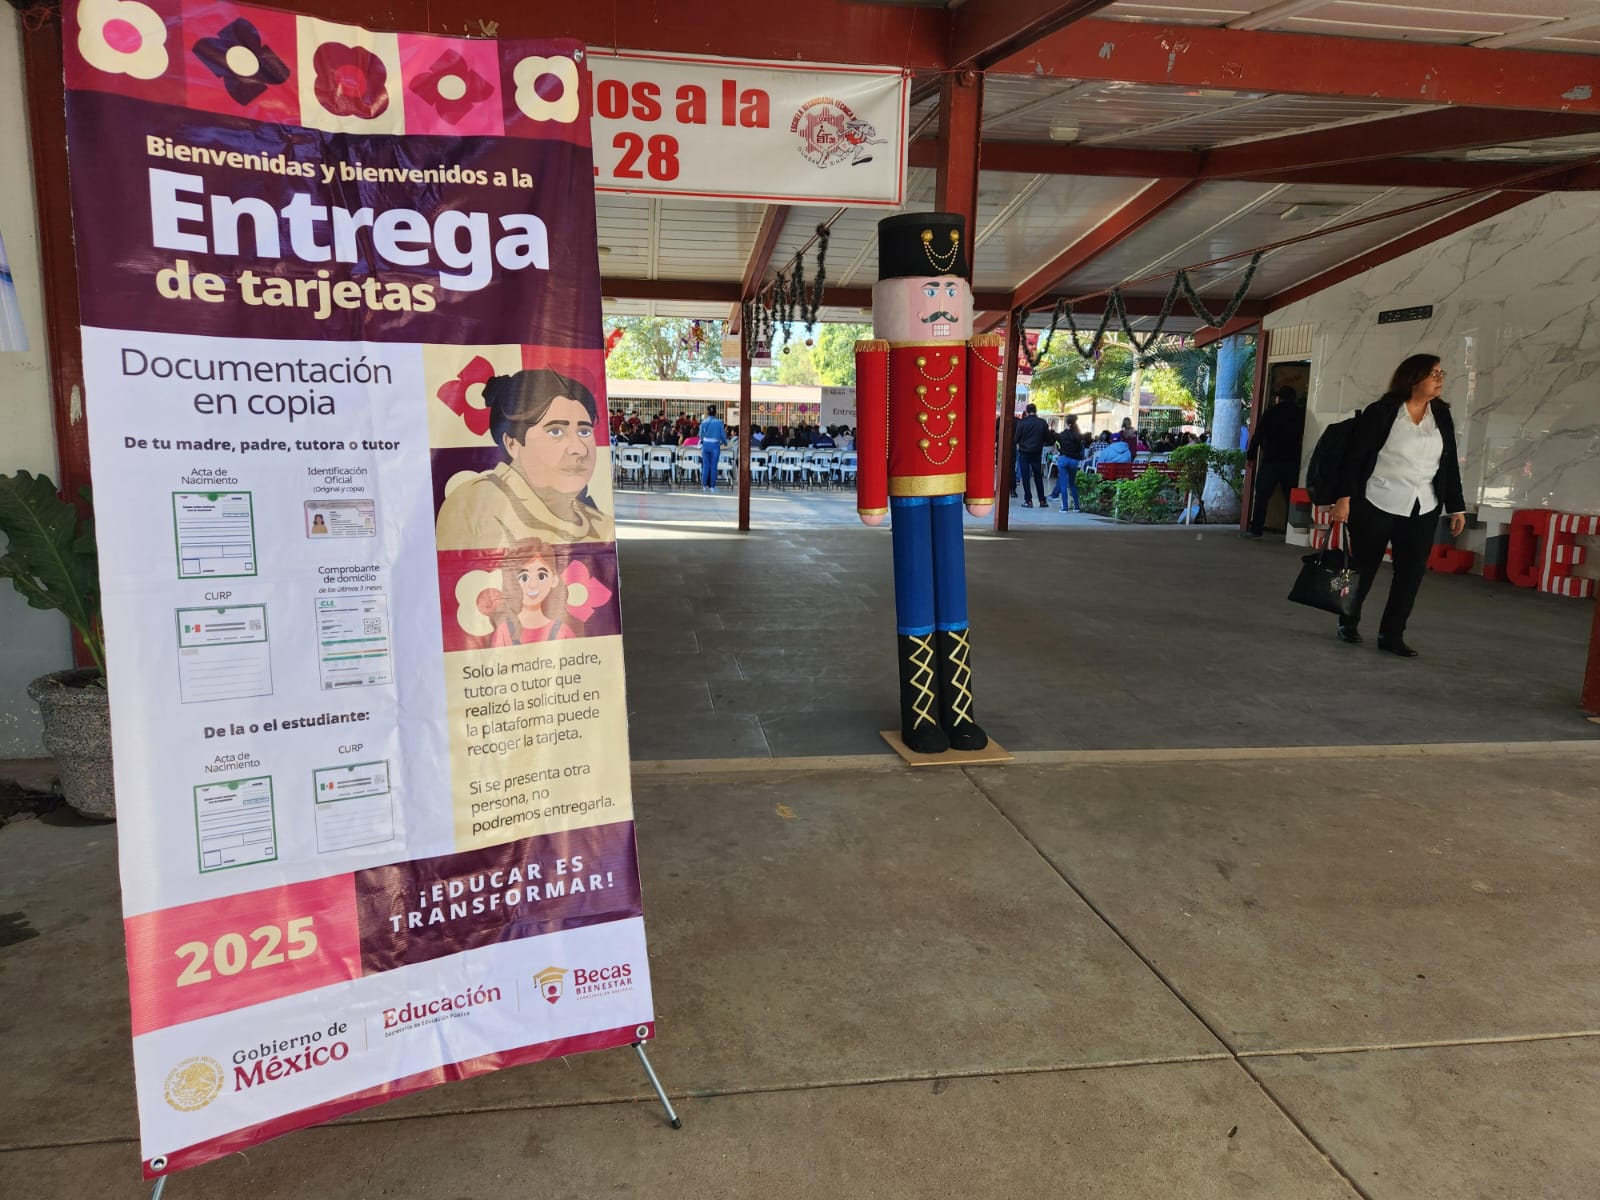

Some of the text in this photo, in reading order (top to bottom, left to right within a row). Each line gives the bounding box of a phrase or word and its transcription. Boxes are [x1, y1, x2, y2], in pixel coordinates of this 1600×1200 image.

[675, 84, 707, 125] a
[722, 79, 770, 129] la
[146, 134, 533, 188] Bienvenidas y bienvenidos a la
[612, 131, 680, 182] 28
[148, 167, 550, 291] Entrega
[155, 259, 437, 320] de tarjetas
[120, 347, 393, 385] Documentación
[193, 388, 336, 423] en copia
[832, 408, 856, 417] Entre
[124, 436, 400, 454] De tu madre, padre, tutora o tutor
[181, 475, 238, 485] Nacimiento
[191, 467, 227, 477] Acta de
[307, 466, 368, 477] Identificación
[324, 475, 353, 485] Oficial
[313, 485, 340, 494] (Original
[346, 486, 365, 494] copia)
[318, 564, 380, 578] Comprobante
[323, 573, 377, 584] de domicilio
[204, 591, 232, 601] CURP
[318, 586, 327, 594] de
[462, 652, 602, 680] Solo la madre, padre,
[464, 672, 582, 699] tutora o tutor que
[465, 689, 601, 718] realizó la solicitud en
[203, 711, 370, 739] De la o el estudiante:
[466, 707, 600, 739] la plataforma puede
[338, 743, 364, 754] CURP
[467, 728, 582, 756] recoger la tarjeta.
[204, 758, 260, 774] Nacimiento
[214, 751, 250, 764] Acta de
[469, 763, 591, 795] Si se presenta otra
[471, 788, 550, 817] persona, no
[472, 795, 616, 836] podremos entregarla.
[419, 855, 584, 908] ¡EDUCAR ES
[389, 871, 615, 934] TRANSFORMAR!
[174, 915, 318, 987] 2025
[573, 963, 631, 986] Becas
[576, 978, 632, 995] BIENESTAR
[383, 984, 502, 1029] Educación
[232, 1020, 348, 1065] Gobierno de
[233, 1040, 349, 1093] México
